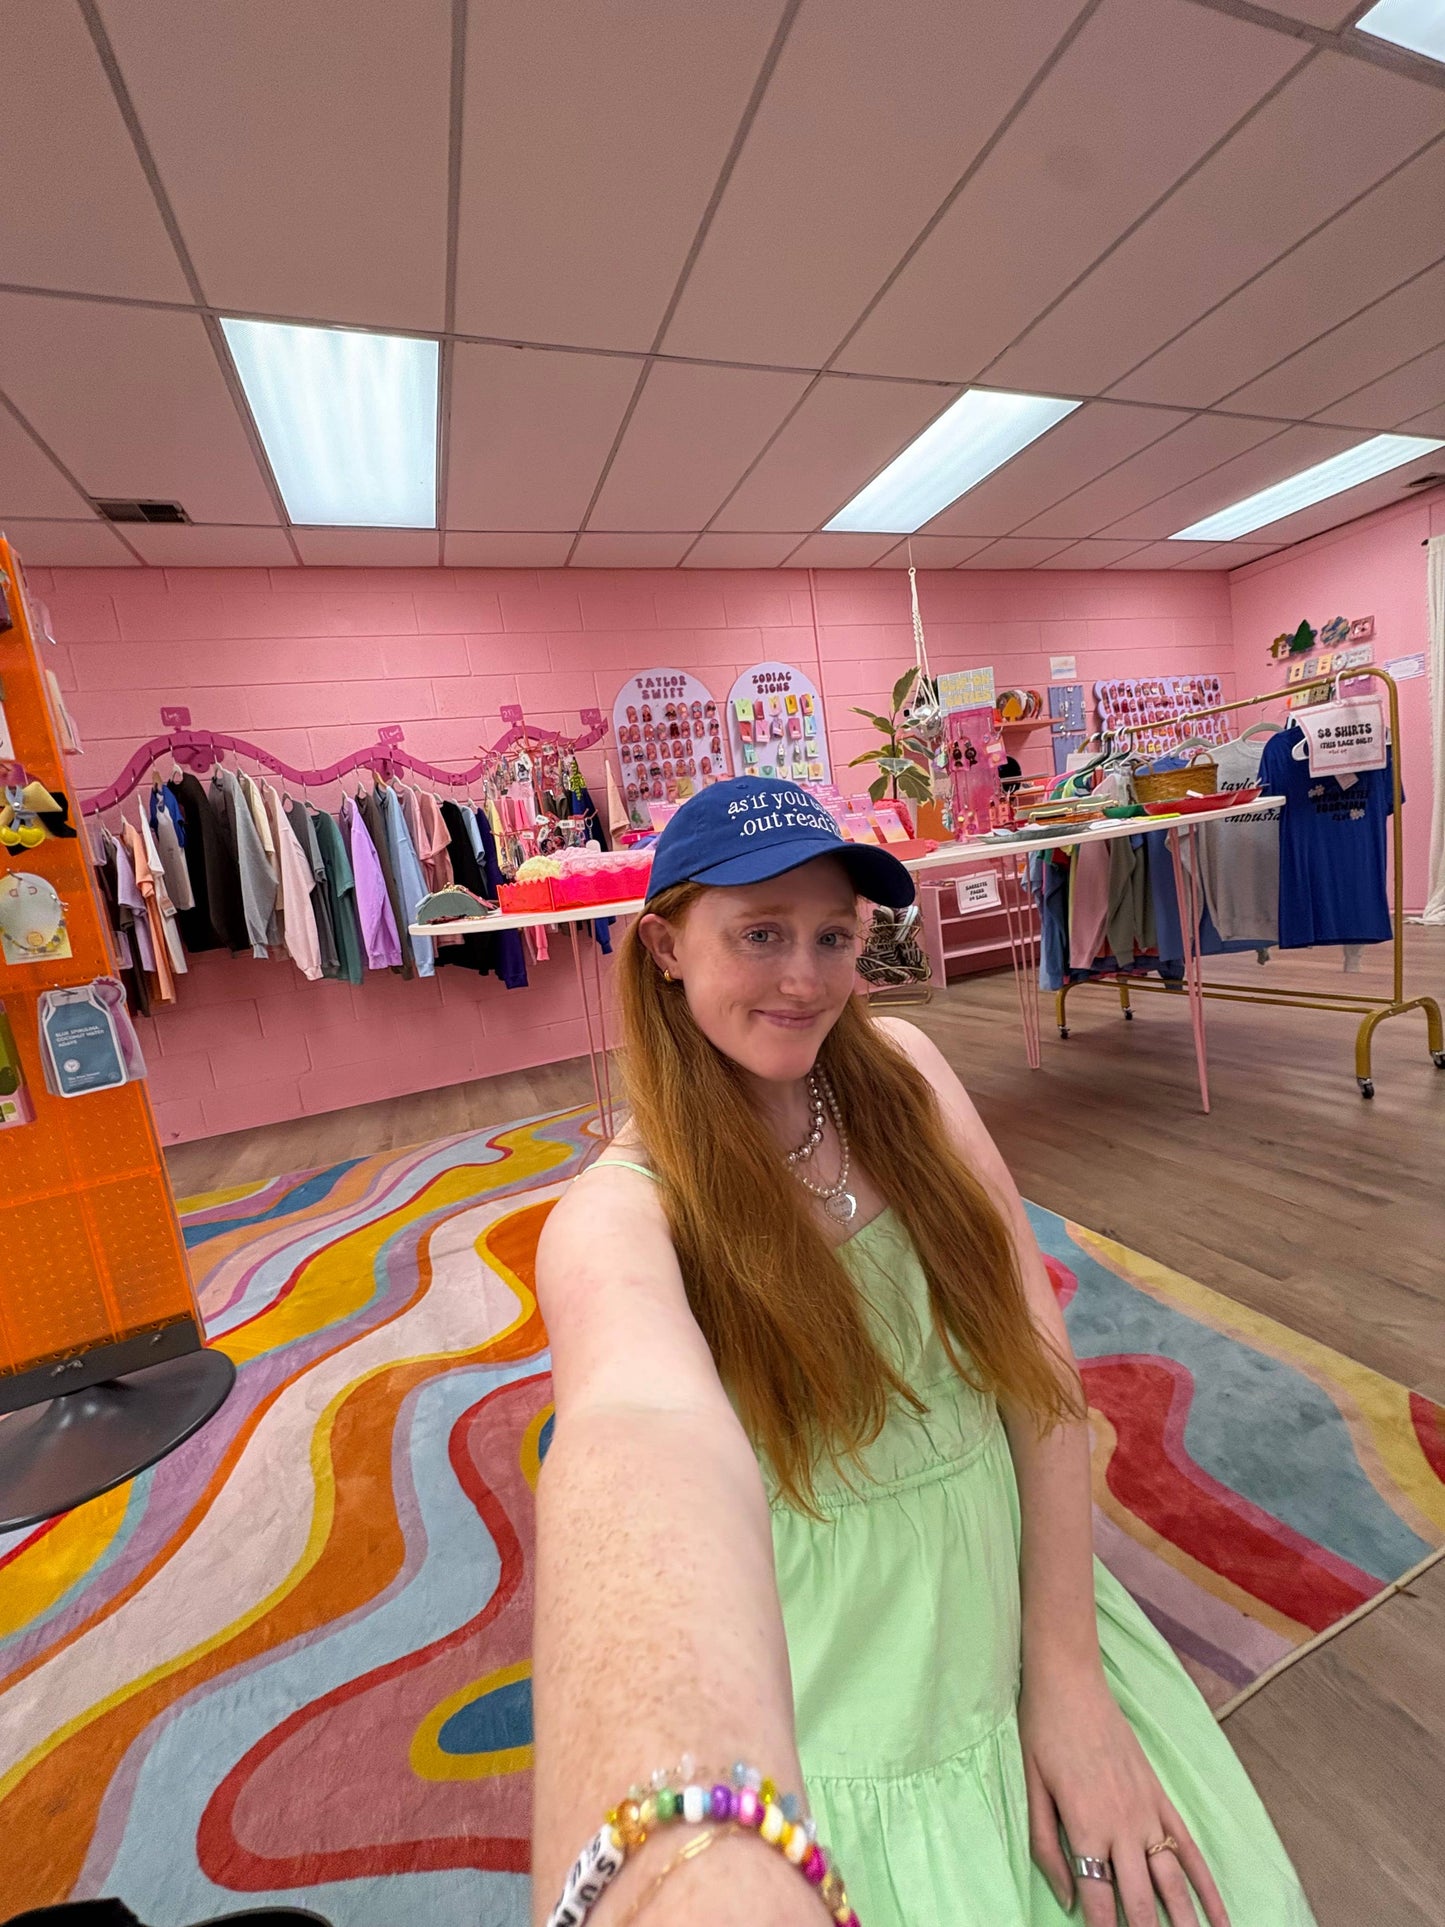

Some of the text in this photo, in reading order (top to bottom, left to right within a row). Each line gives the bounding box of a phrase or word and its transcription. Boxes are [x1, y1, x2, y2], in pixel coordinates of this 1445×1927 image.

[635, 675, 687, 689] TAYLOR
[751, 671, 792, 684] ZODIAC
[641, 687, 684, 701] SWIFT
[756, 681, 790, 695] SIGNS
[1317, 723, 1373, 740] $8 SHIRTS
[727, 799, 749, 816] as
[747, 791, 769, 810] if
[770, 790, 809, 810] you
[56, 1032, 85, 1043] COCONUT
